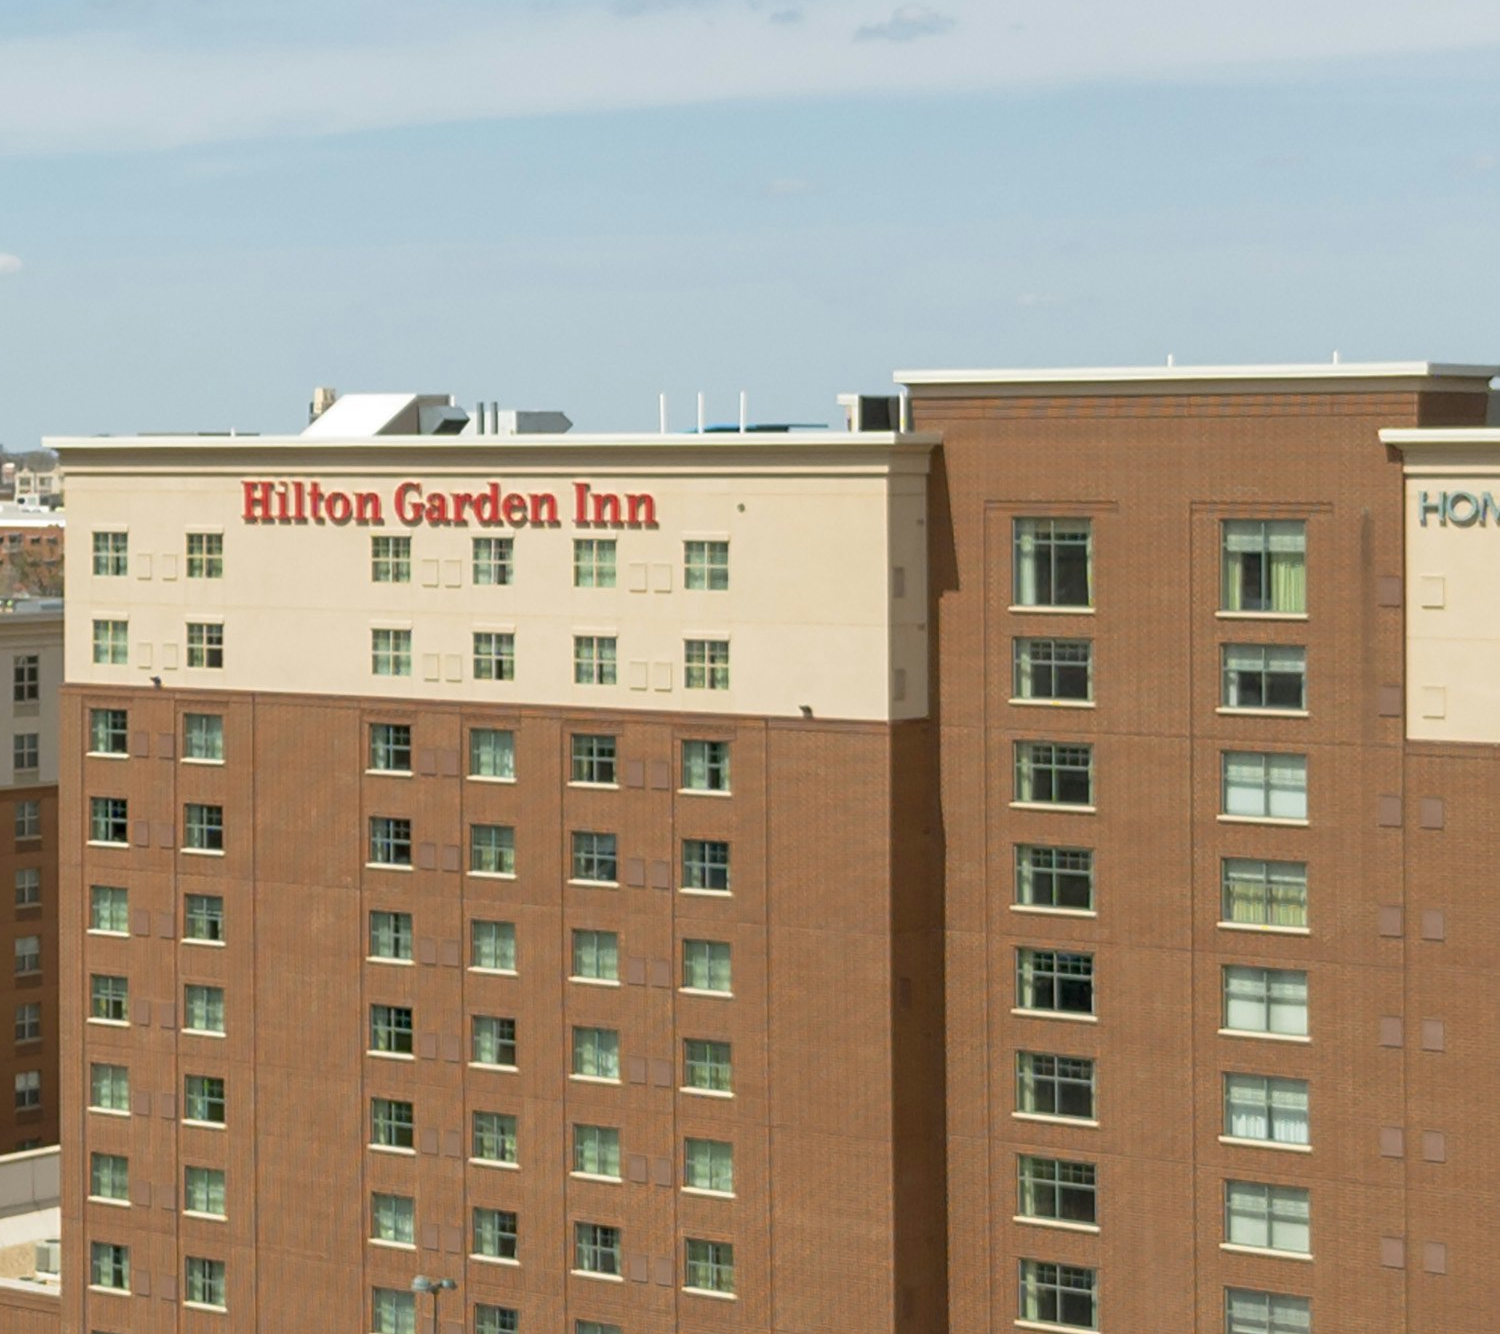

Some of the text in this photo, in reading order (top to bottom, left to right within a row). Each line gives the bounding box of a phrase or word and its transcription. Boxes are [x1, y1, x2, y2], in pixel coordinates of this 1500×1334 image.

[241, 479, 658, 529] Hilton Garden Inn
